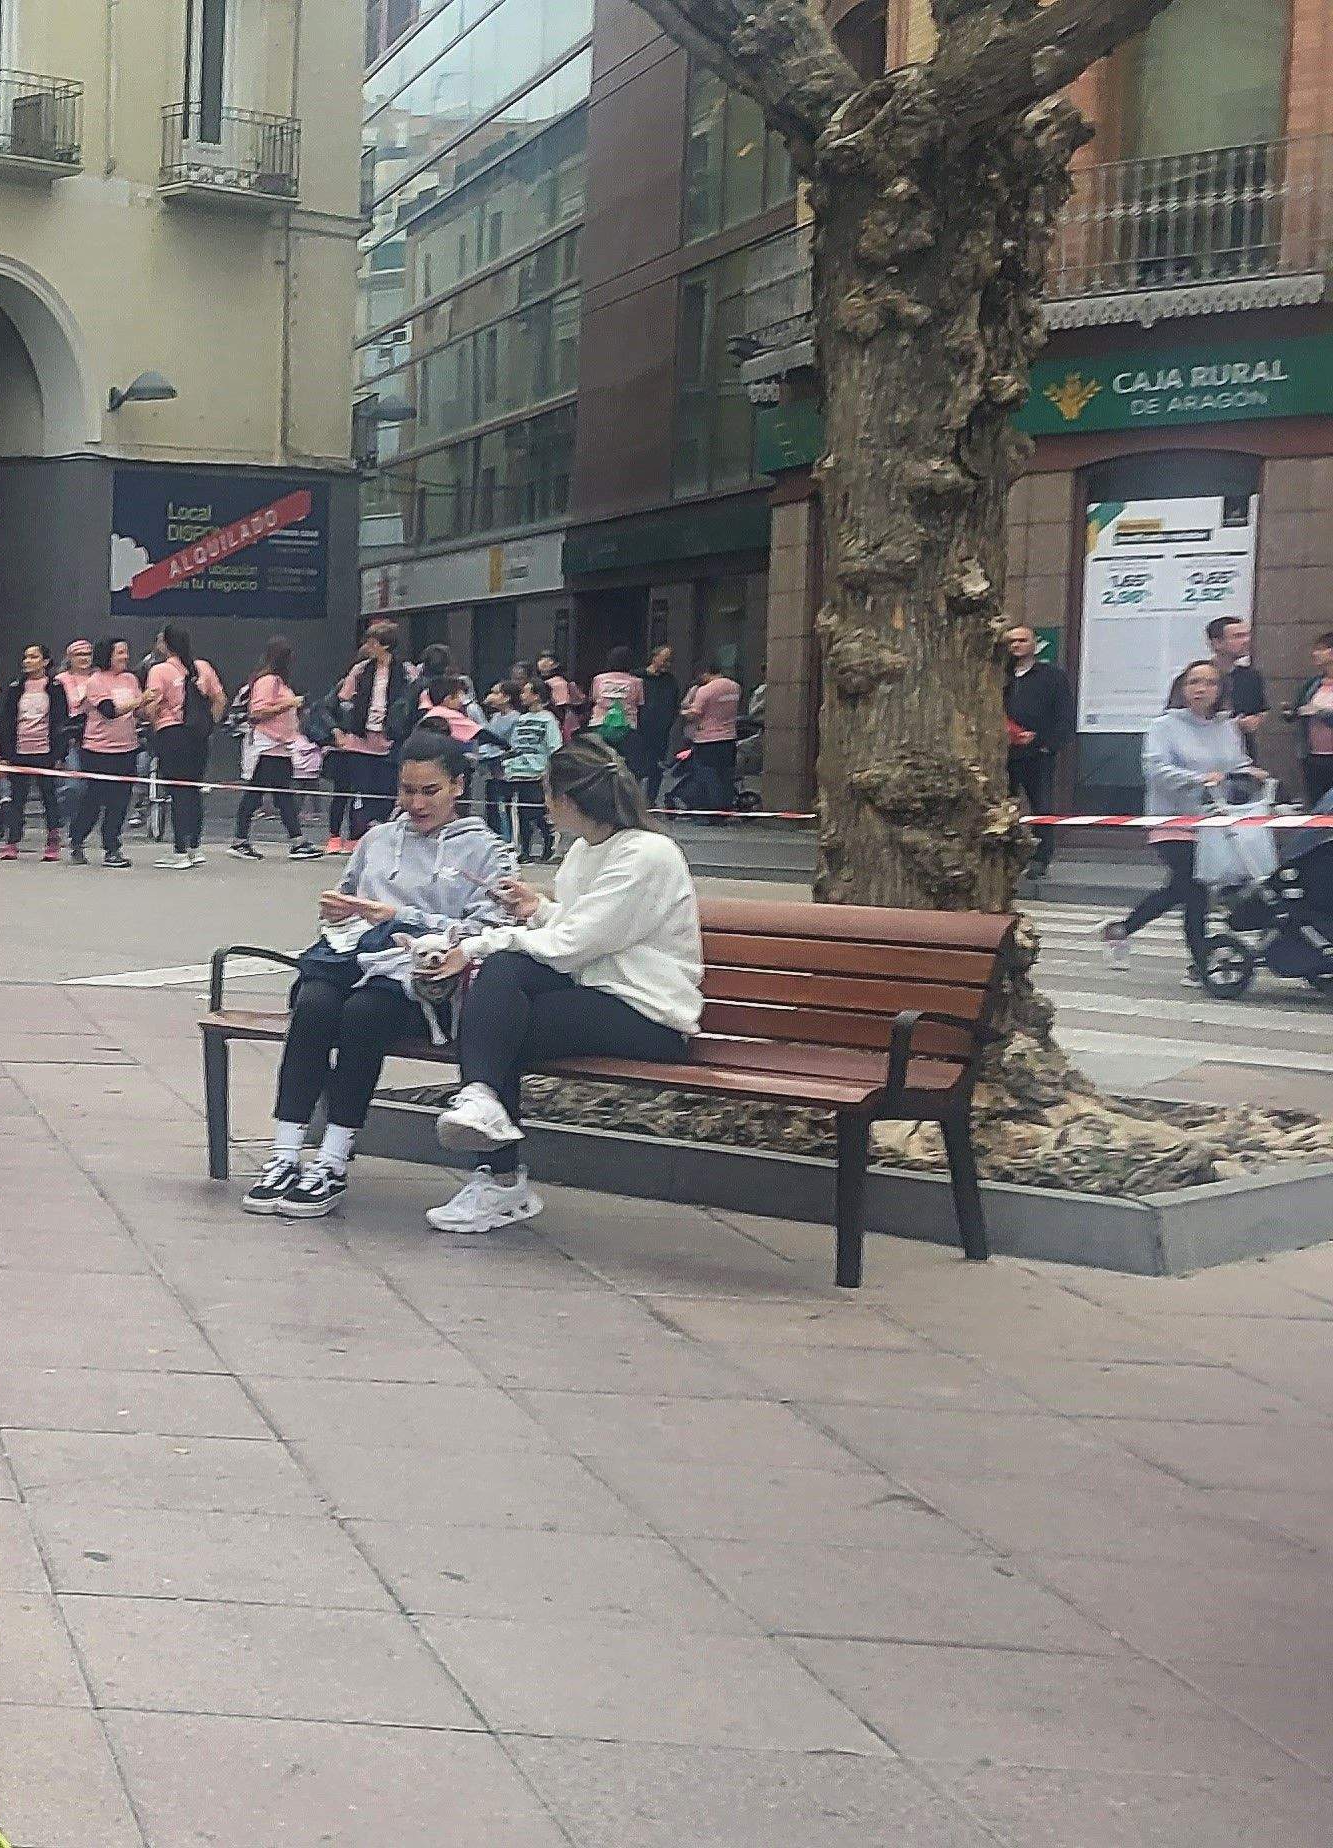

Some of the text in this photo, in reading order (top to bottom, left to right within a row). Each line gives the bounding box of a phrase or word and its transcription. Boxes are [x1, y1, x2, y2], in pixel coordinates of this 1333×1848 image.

[1112, 359, 1289, 395] CAJA RURAL
[1131, 398, 1161, 417] DE
[167, 501, 211, 522] Local
[168, 509, 278, 579] ALQUILADO
[207, 579, 259, 594] negocio
